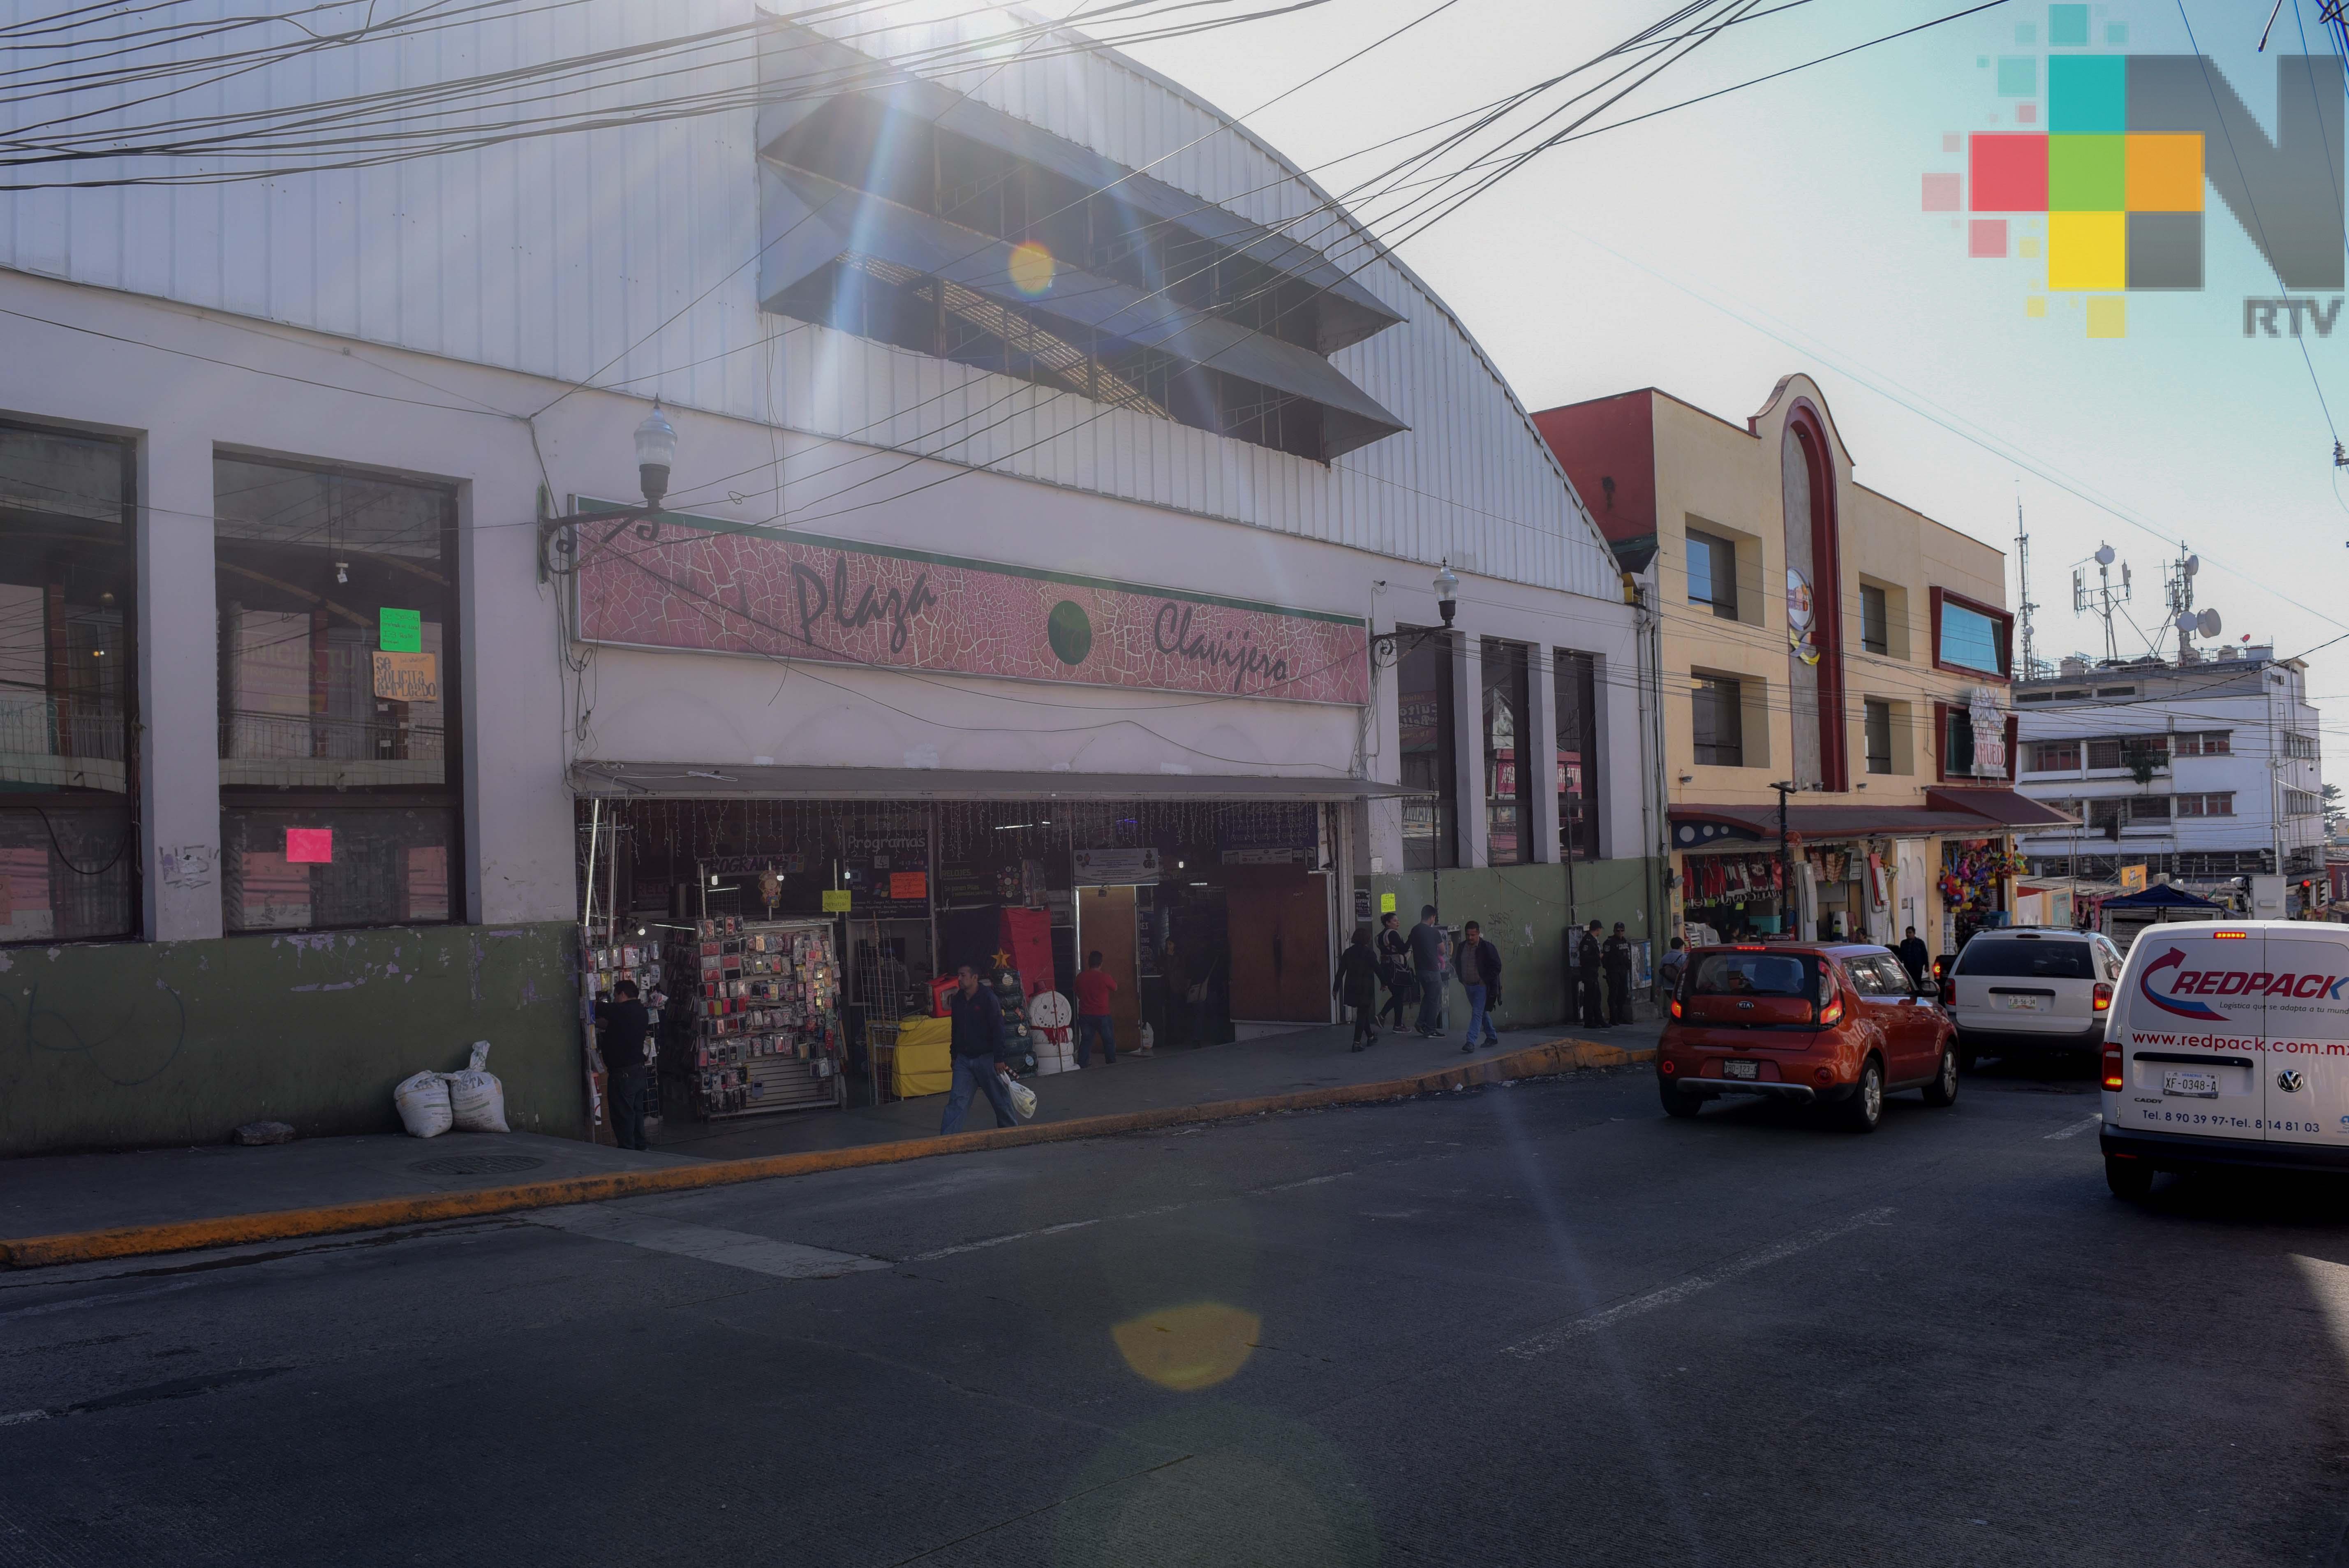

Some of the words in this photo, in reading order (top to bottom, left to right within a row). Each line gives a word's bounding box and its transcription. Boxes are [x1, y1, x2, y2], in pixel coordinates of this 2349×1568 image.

[792, 556, 937, 654] Plaza
[1154, 603, 1288, 691] Clavijero
[329, 648, 356, 669] TU
[1974, 727, 1987, 740] CASA
[848, 835, 925, 853] Programas
[2170, 971, 2349, 1000] REDPACK
[2280, 1004, 2307, 1013] adapta
[2165, 1078, 2216, 1092] XF-0348-A
[2143, 1110, 2161, 1121] Tel.
[2165, 1112, 2172, 1121] 8
[2176, 1113, 2189, 1123] 90
[2193, 1115, 2207, 1124] 39
[2255, 1119, 2262, 1129] 8
[2267, 1120, 2281, 1130] 14
[2285, 1122, 2298, 1131] 81
[2304, 1122, 2320, 1133] 03
